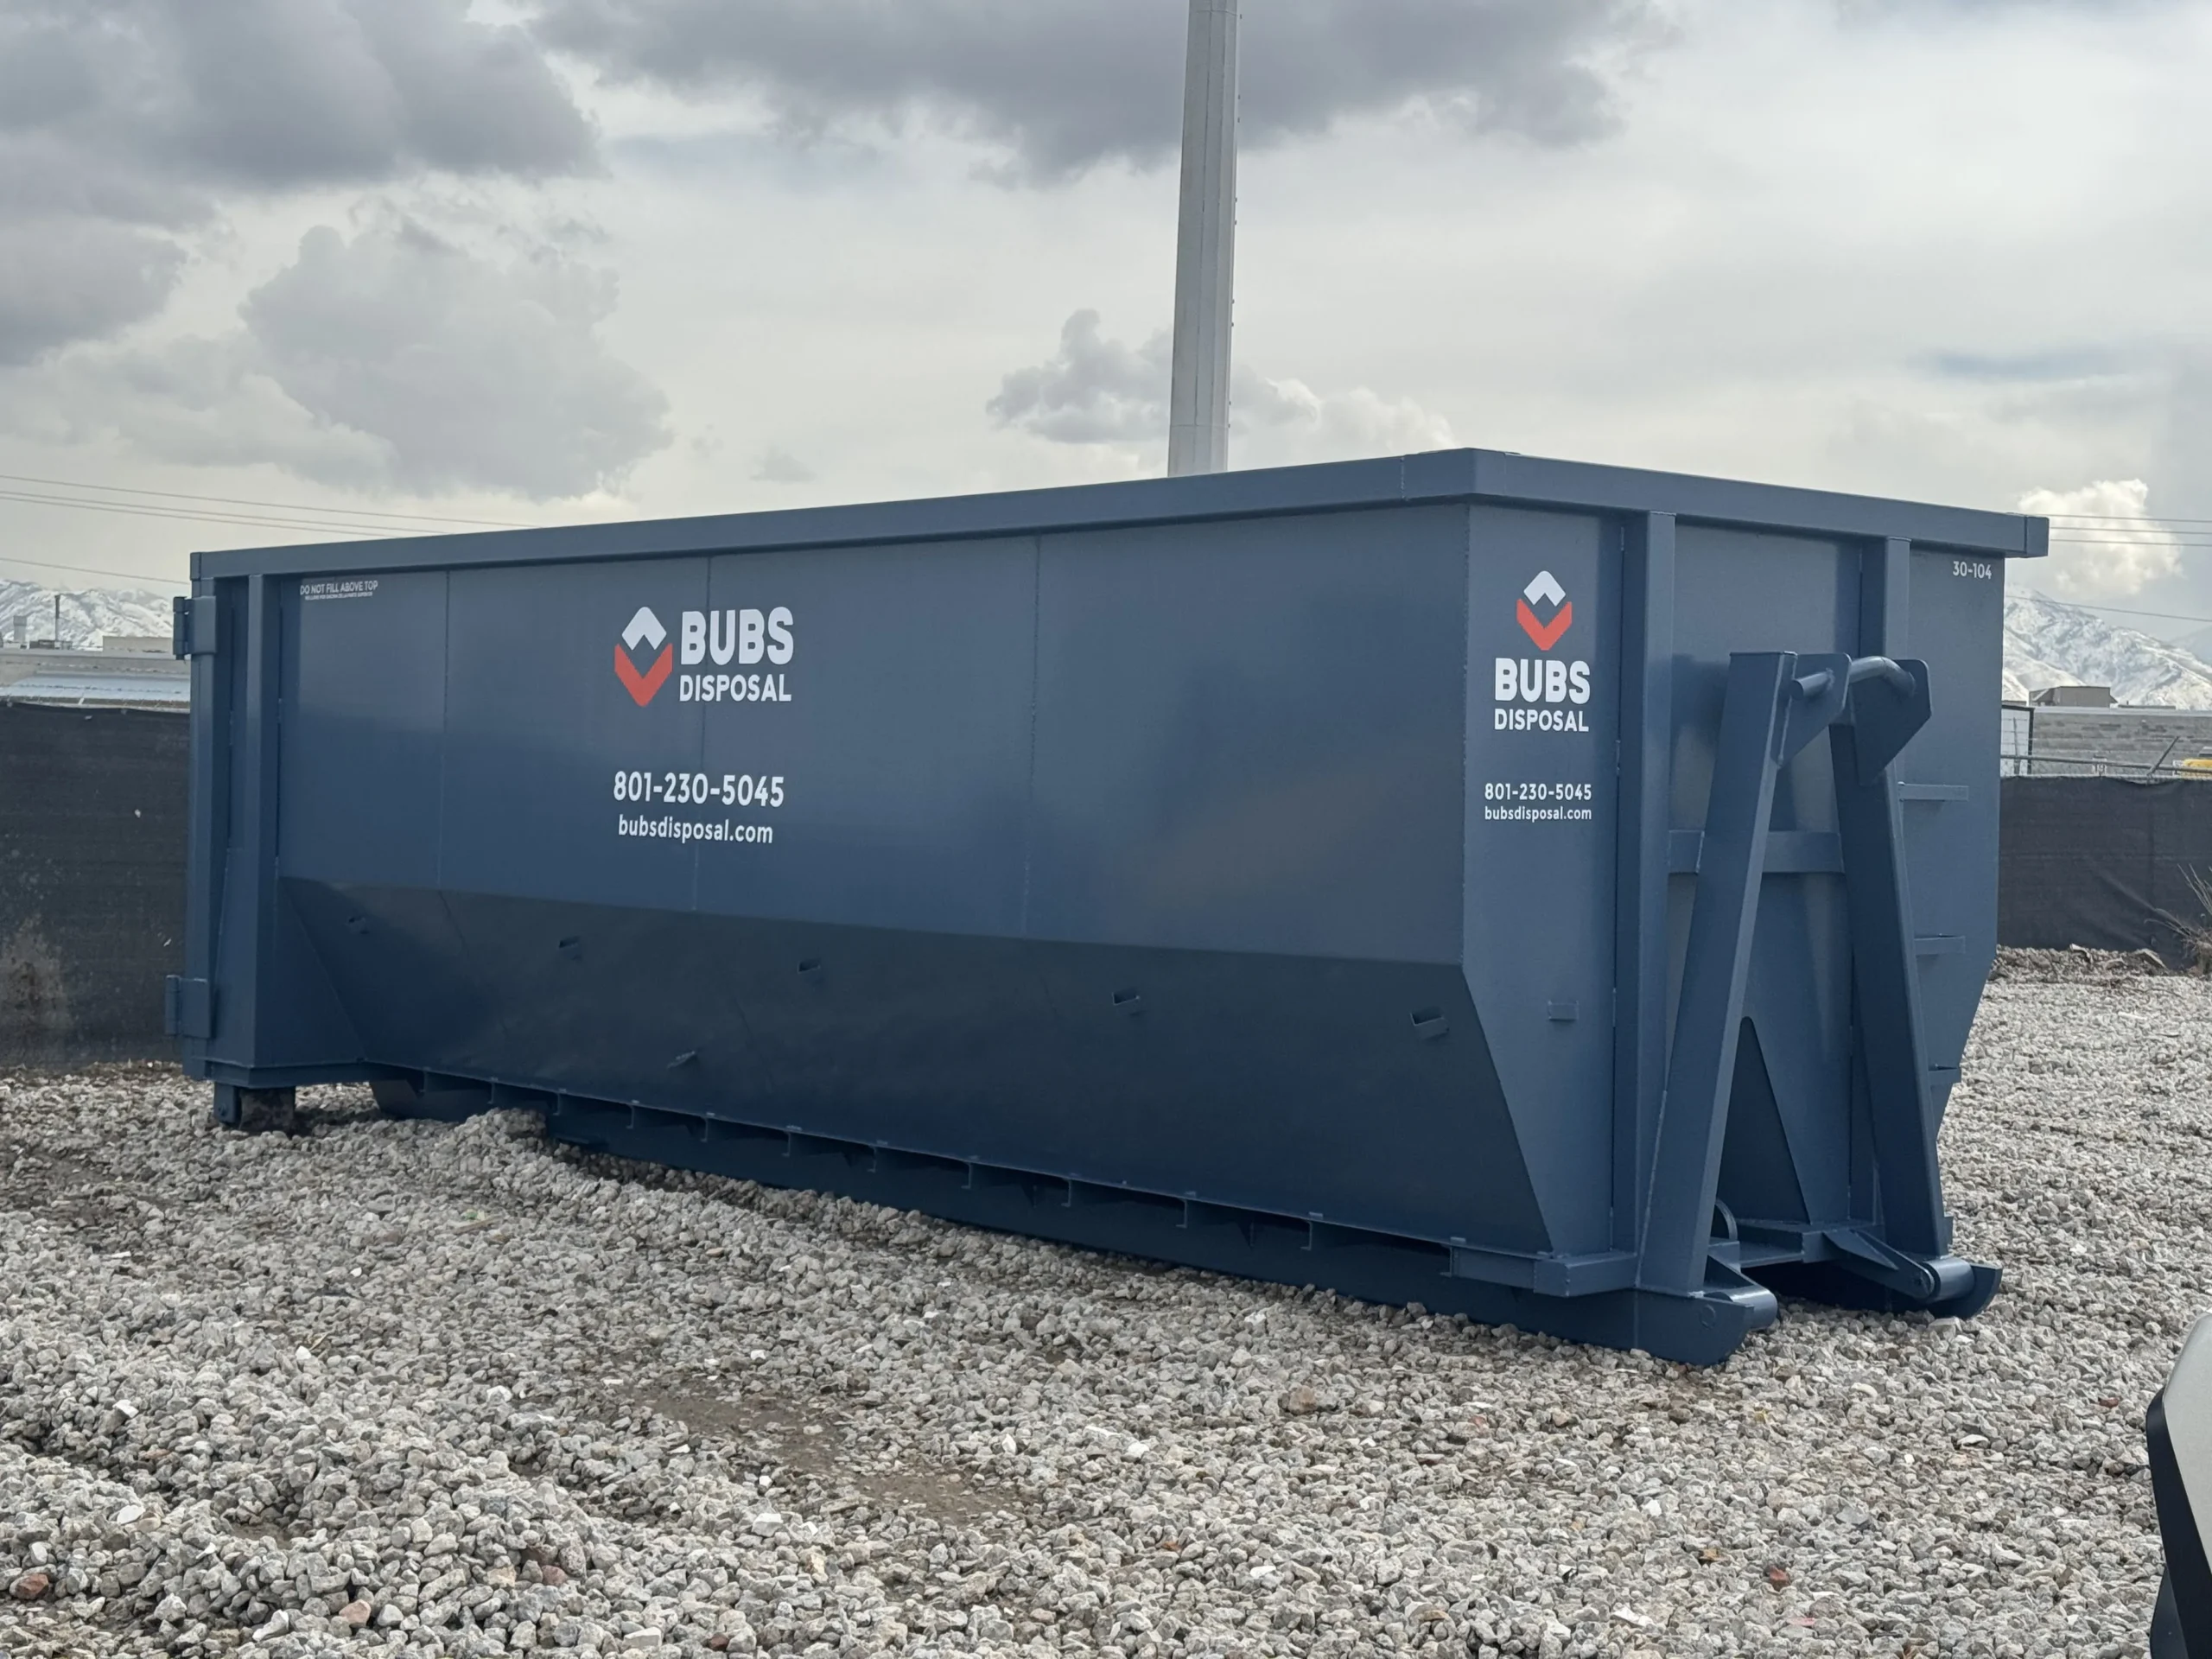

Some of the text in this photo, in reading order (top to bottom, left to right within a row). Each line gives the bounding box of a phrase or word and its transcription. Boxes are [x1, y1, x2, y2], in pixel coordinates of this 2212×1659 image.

[1953, 561, 1992, 580] 30-104
[300, 580, 378, 595] DO NOT FILL ABOVE TOP
[681, 607, 793, 665] BUBS
[679, 674, 791, 702] DISPOSAL
[1495, 658, 1590, 704] BUBS
[1494, 709, 1589, 732] DISPOSAL
[613, 771, 784, 807] 801-230-5045
[1484, 783, 1592, 800] 801-230-5045
[1484, 806, 1592, 823] bubsdisposal.com
[619, 814, 773, 843] bubsdisposal.com
